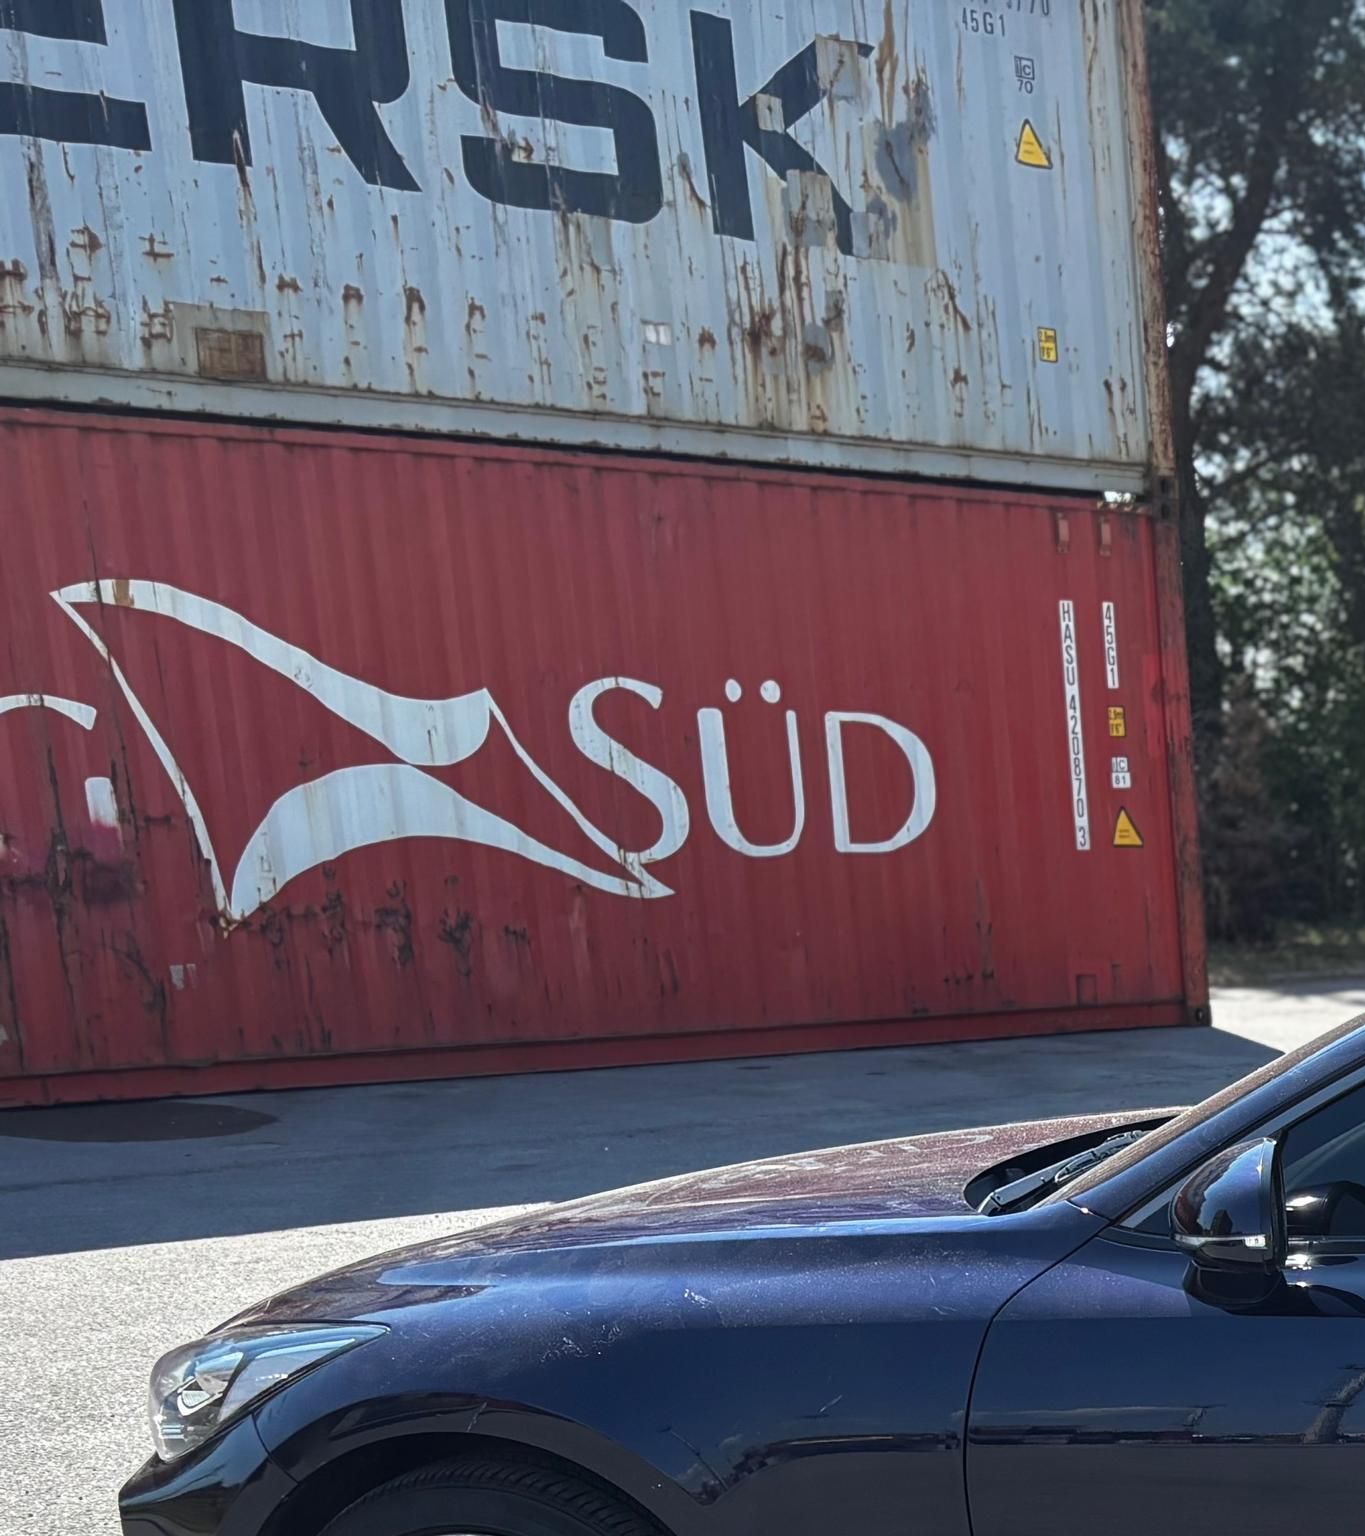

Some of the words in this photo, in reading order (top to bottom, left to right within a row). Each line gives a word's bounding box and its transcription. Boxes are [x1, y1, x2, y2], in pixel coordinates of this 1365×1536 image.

[962, 7, 1005, 37] 45G1
[1017, 79, 1033, 94] 70
[1105, 604, 1116, 687] 45G1
[1062, 602, 1076, 686] HASU
[1069, 694, 1085, 818] 420870
[1078, 827, 1087, 847] 3
[569, 677, 936, 864] SÜD
[1115, 775, 1126, 785] 81
